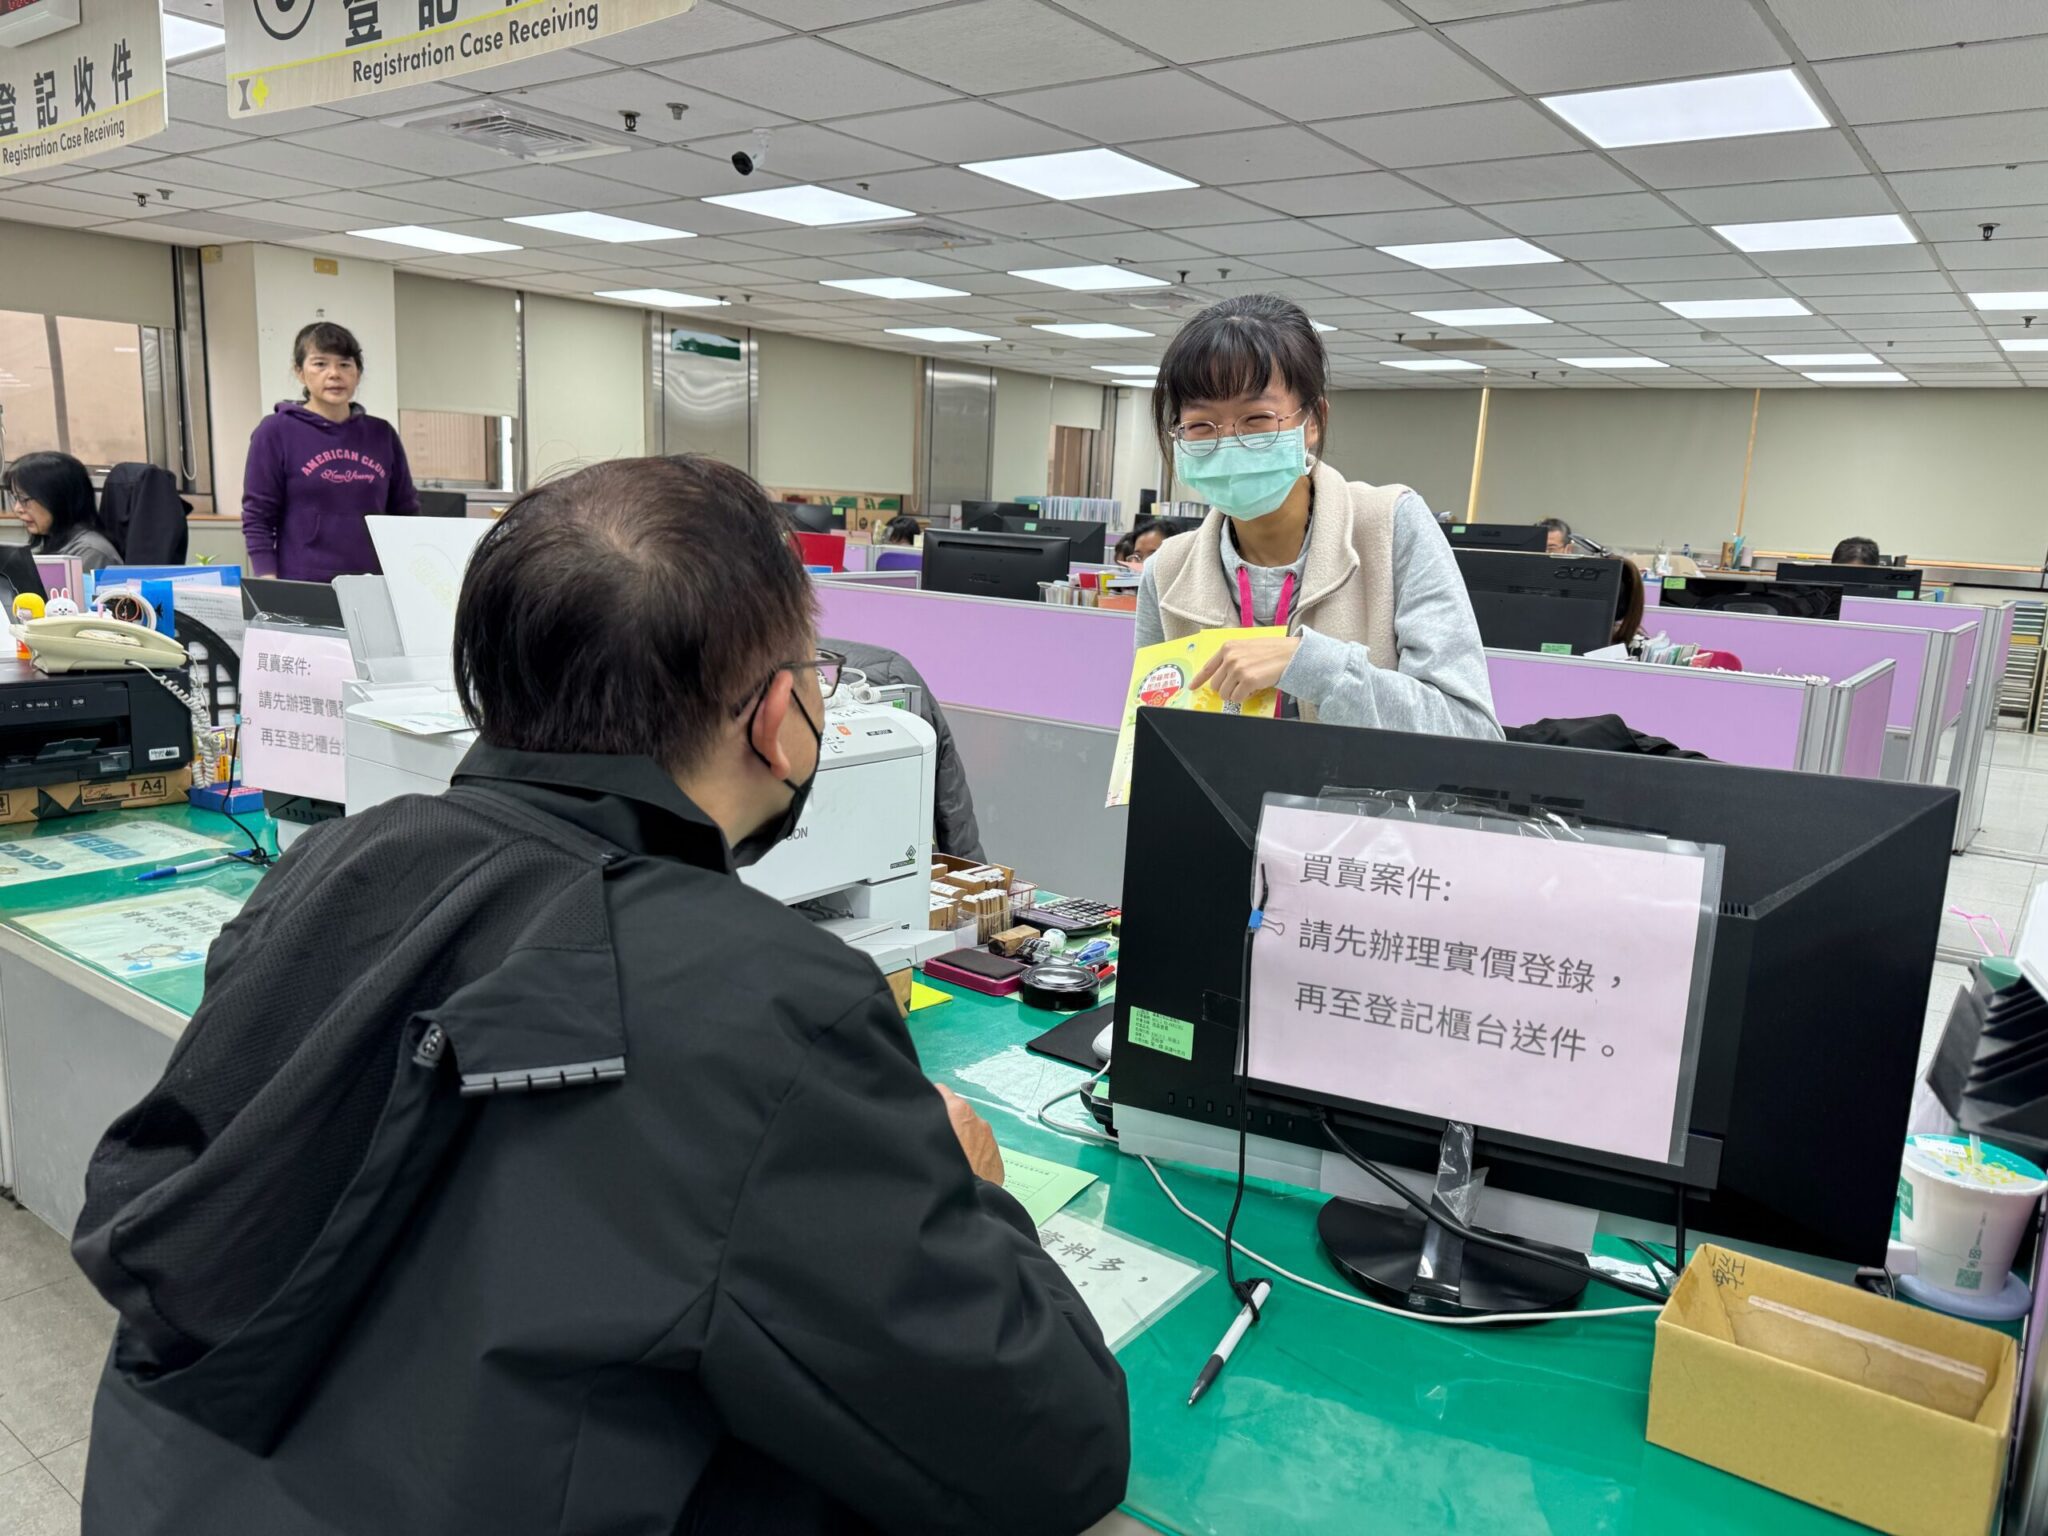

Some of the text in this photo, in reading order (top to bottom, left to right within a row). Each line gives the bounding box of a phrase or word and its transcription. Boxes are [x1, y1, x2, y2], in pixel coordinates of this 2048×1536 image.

[353, 42, 455, 84] Registration
[460, 31, 504, 58] Case
[508, 2, 599, 46] Receiving
[0, 38, 133, 137] 登記收件
[2, 117, 125, 166] Registration Case Receiving
[301, 448, 359, 477] AMERICAN
[1553, 564, 1609, 582] acer
[260, 727, 345, 756] 再至登記櫃台
[141, 779, 163, 792] A4
[1299, 854, 1452, 902] 買賣案件:
[1299, 919, 1622, 993] 請先辦理實價登錄，
[1294, 981, 1616, 1063] 再至登記櫃台送件。
